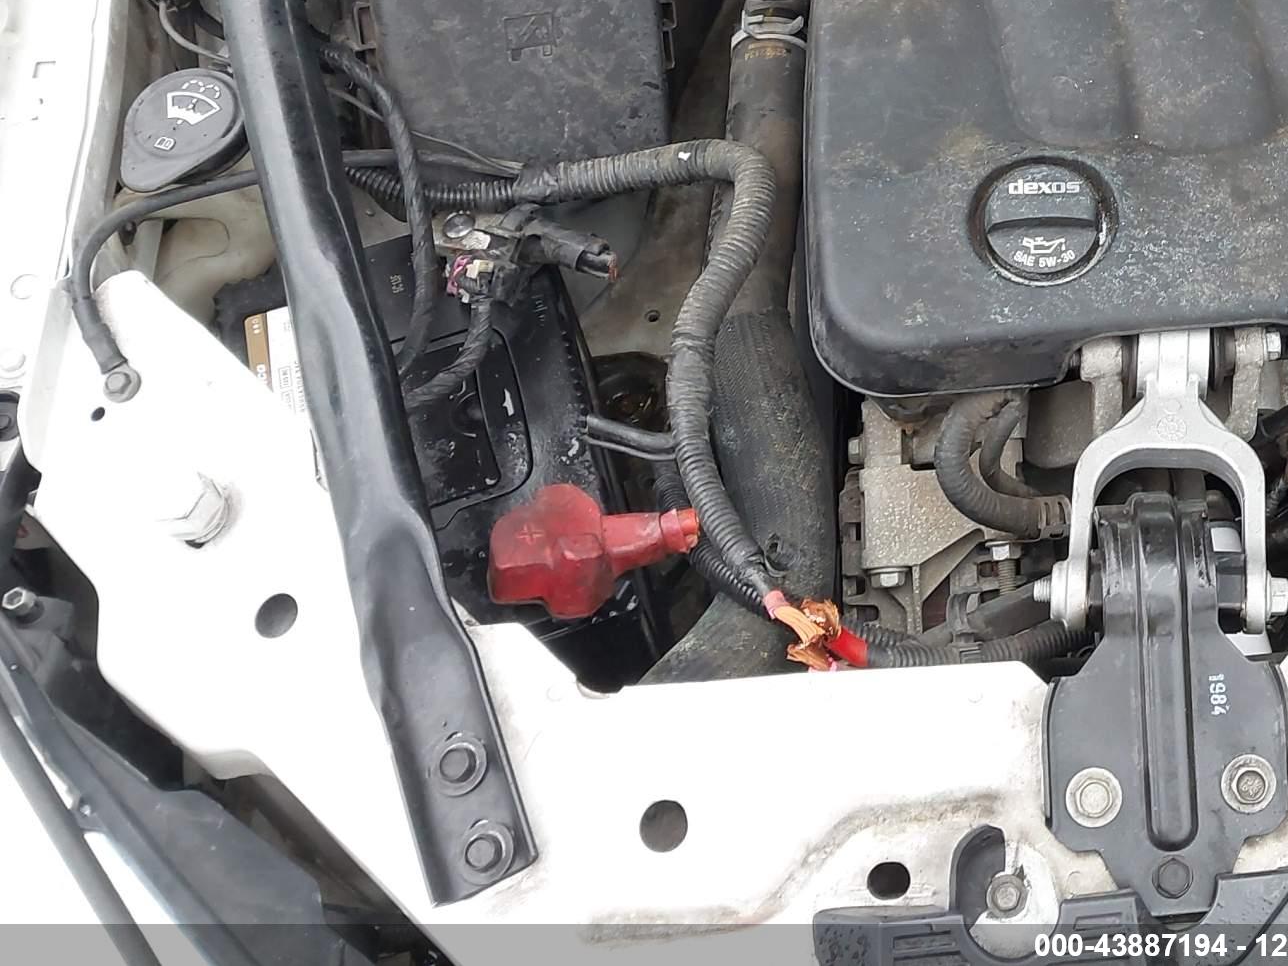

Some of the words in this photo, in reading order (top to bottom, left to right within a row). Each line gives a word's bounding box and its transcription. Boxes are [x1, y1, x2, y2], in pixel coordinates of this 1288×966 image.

[1008, 179, 1082, 194] dexos
[1014, 250, 1035, 267] SAE
[1039, 249, 1076, 268] 5W-30
[1208, 673, 1230, 716] 1984
